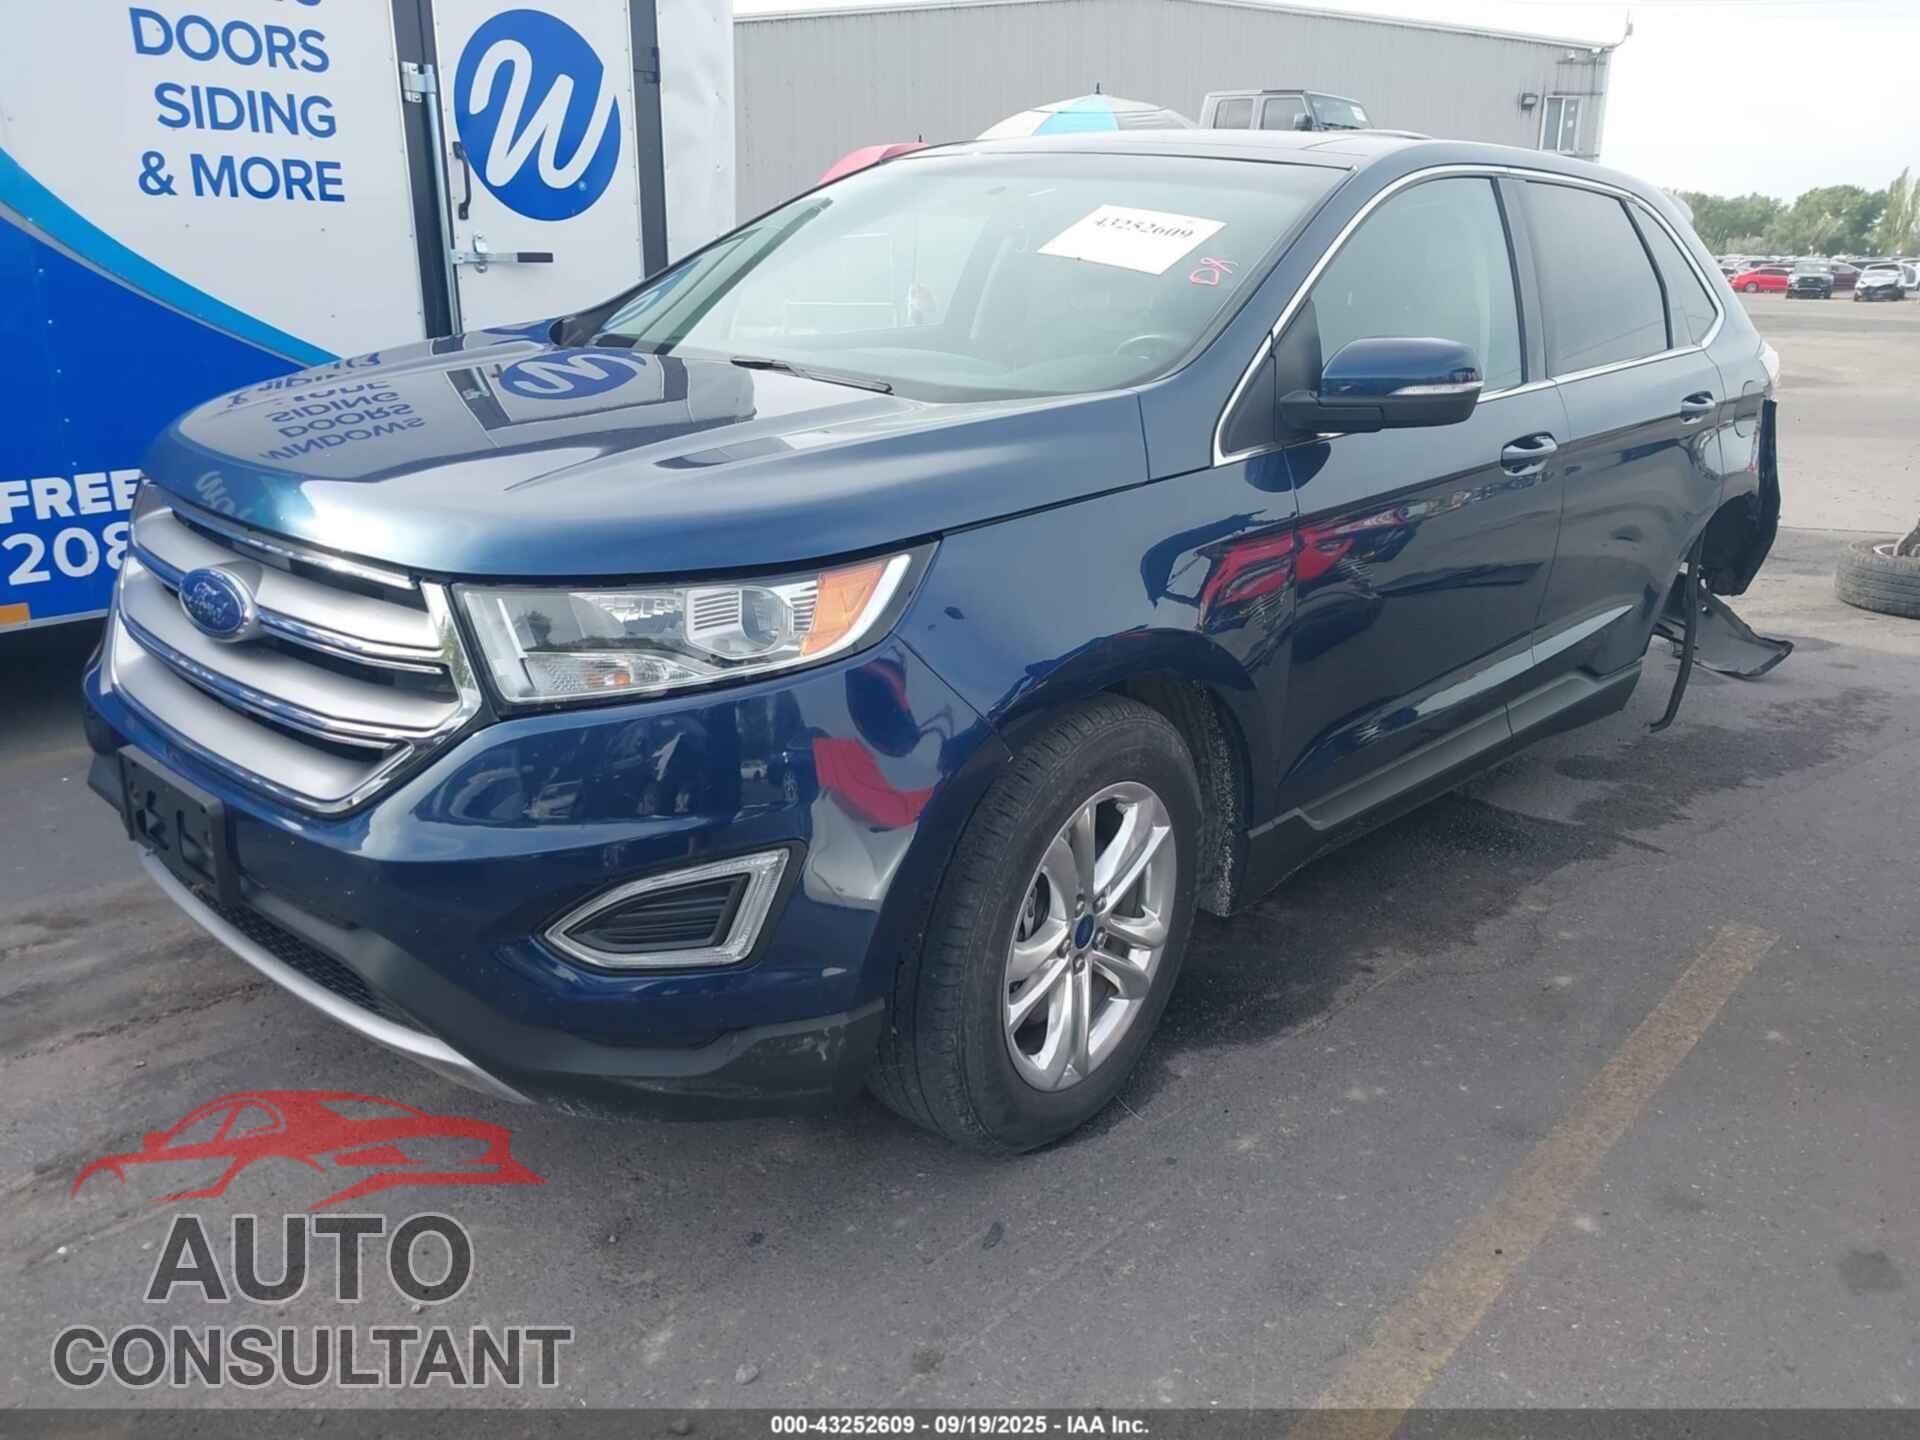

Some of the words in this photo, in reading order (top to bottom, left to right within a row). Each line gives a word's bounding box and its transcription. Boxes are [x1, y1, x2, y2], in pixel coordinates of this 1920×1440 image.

[129, 7, 329, 73] DOORS
[154, 82, 336, 138] SIDING
[138, 150, 178, 196] &
[190, 153, 345, 203] MORE
[0, 469, 142, 524] FREE
